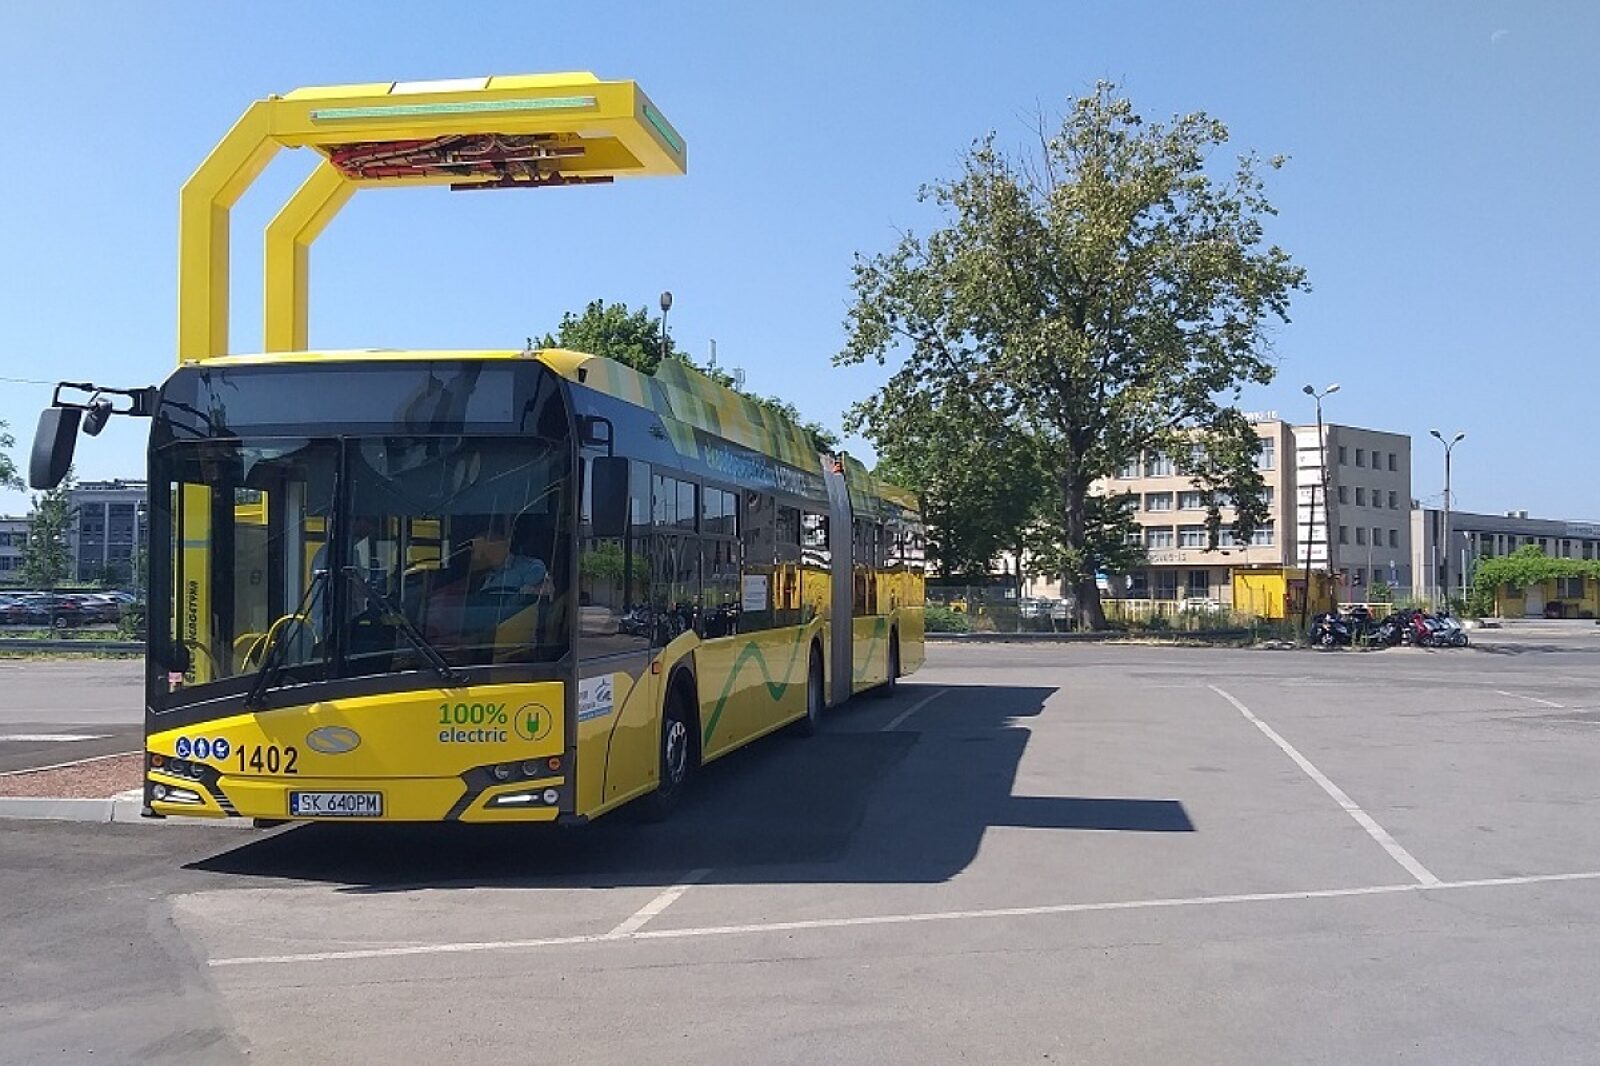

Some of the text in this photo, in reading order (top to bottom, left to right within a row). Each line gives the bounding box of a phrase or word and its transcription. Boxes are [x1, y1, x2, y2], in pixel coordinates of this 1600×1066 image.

[439, 703, 508, 724] 100%
[439, 726, 508, 743] electric
[235, 745, 298, 773] 1402
[302, 794, 377, 811] SK 640PM
